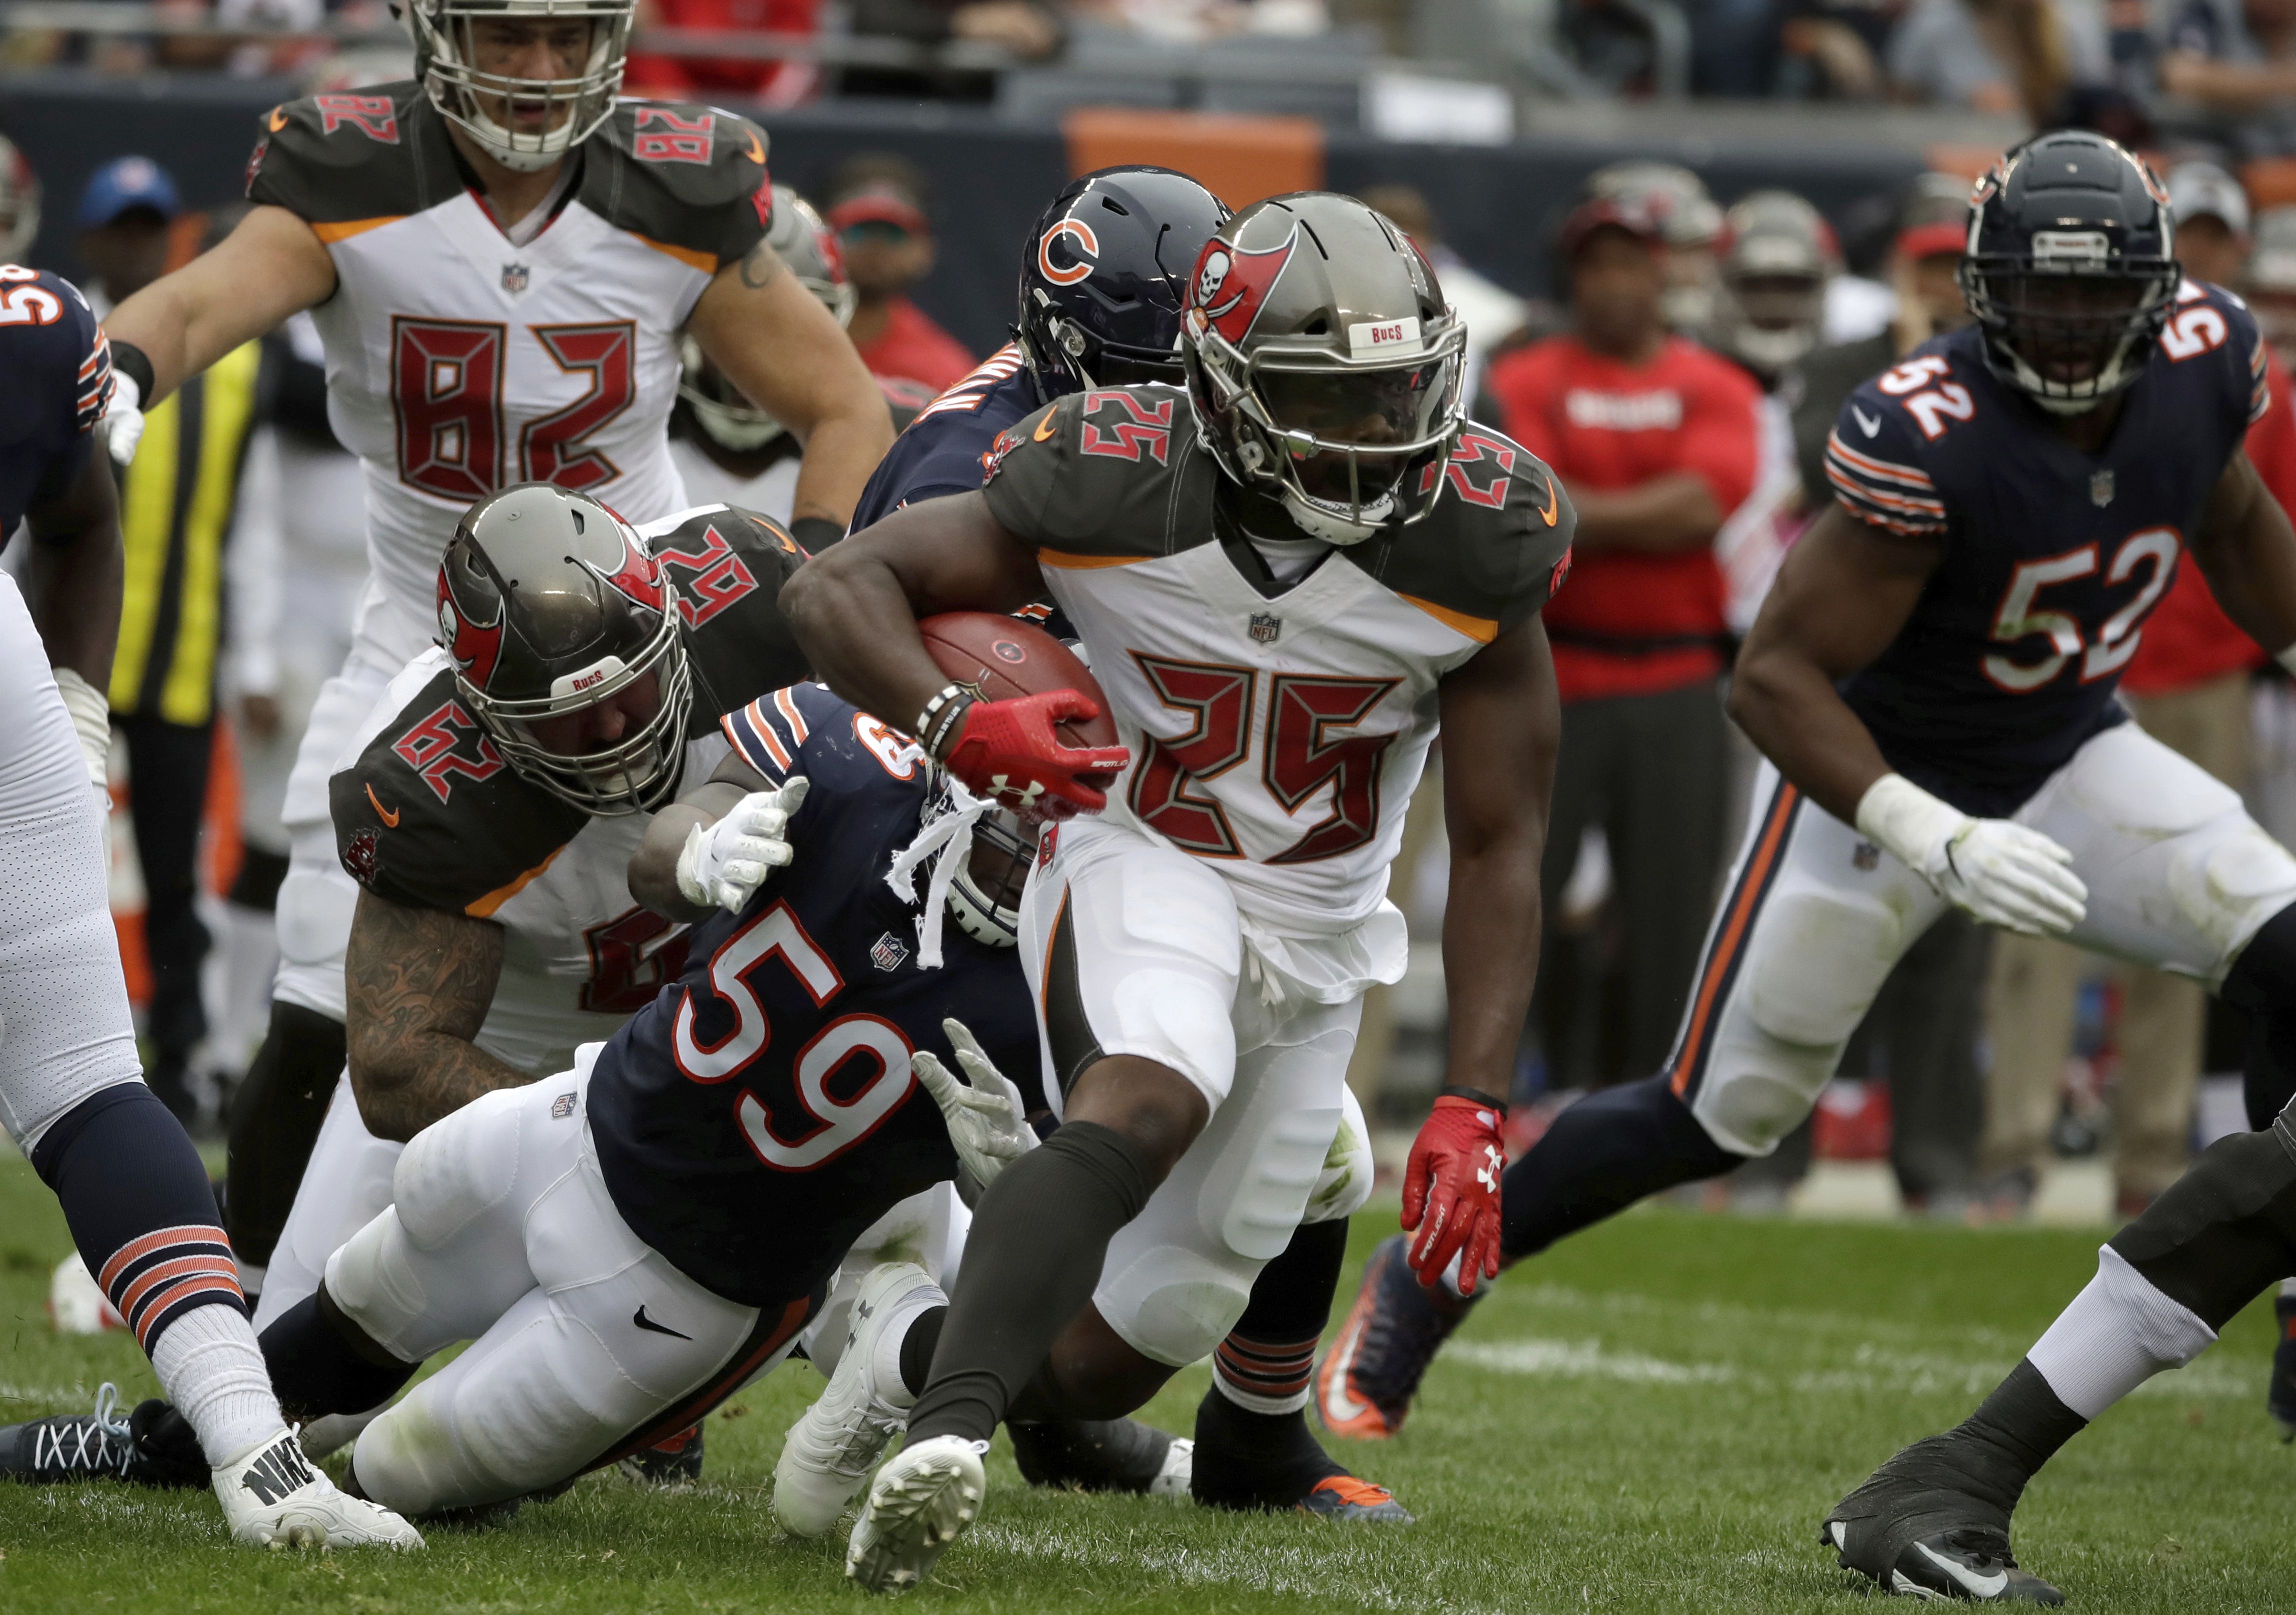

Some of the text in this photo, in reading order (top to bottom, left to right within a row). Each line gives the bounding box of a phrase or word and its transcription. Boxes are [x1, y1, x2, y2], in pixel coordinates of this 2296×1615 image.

[314, 94, 401, 145] 82
[632, 106, 716, 166] 82
[391, 315, 636, 504] 82
[1080, 392, 1175, 468] 25
[1876, 355, 1977, 442] 52
[1417, 433, 1516, 510] 25
[1980, 526, 2182, 694] 52
[391, 698, 507, 806] 62
[1126, 648, 1405, 864] 25
[672, 897, 918, 1173] 59
[1419, 1203, 1446, 1262] SPOTLIGHT
[242, 1436, 316, 1506] NIKE
